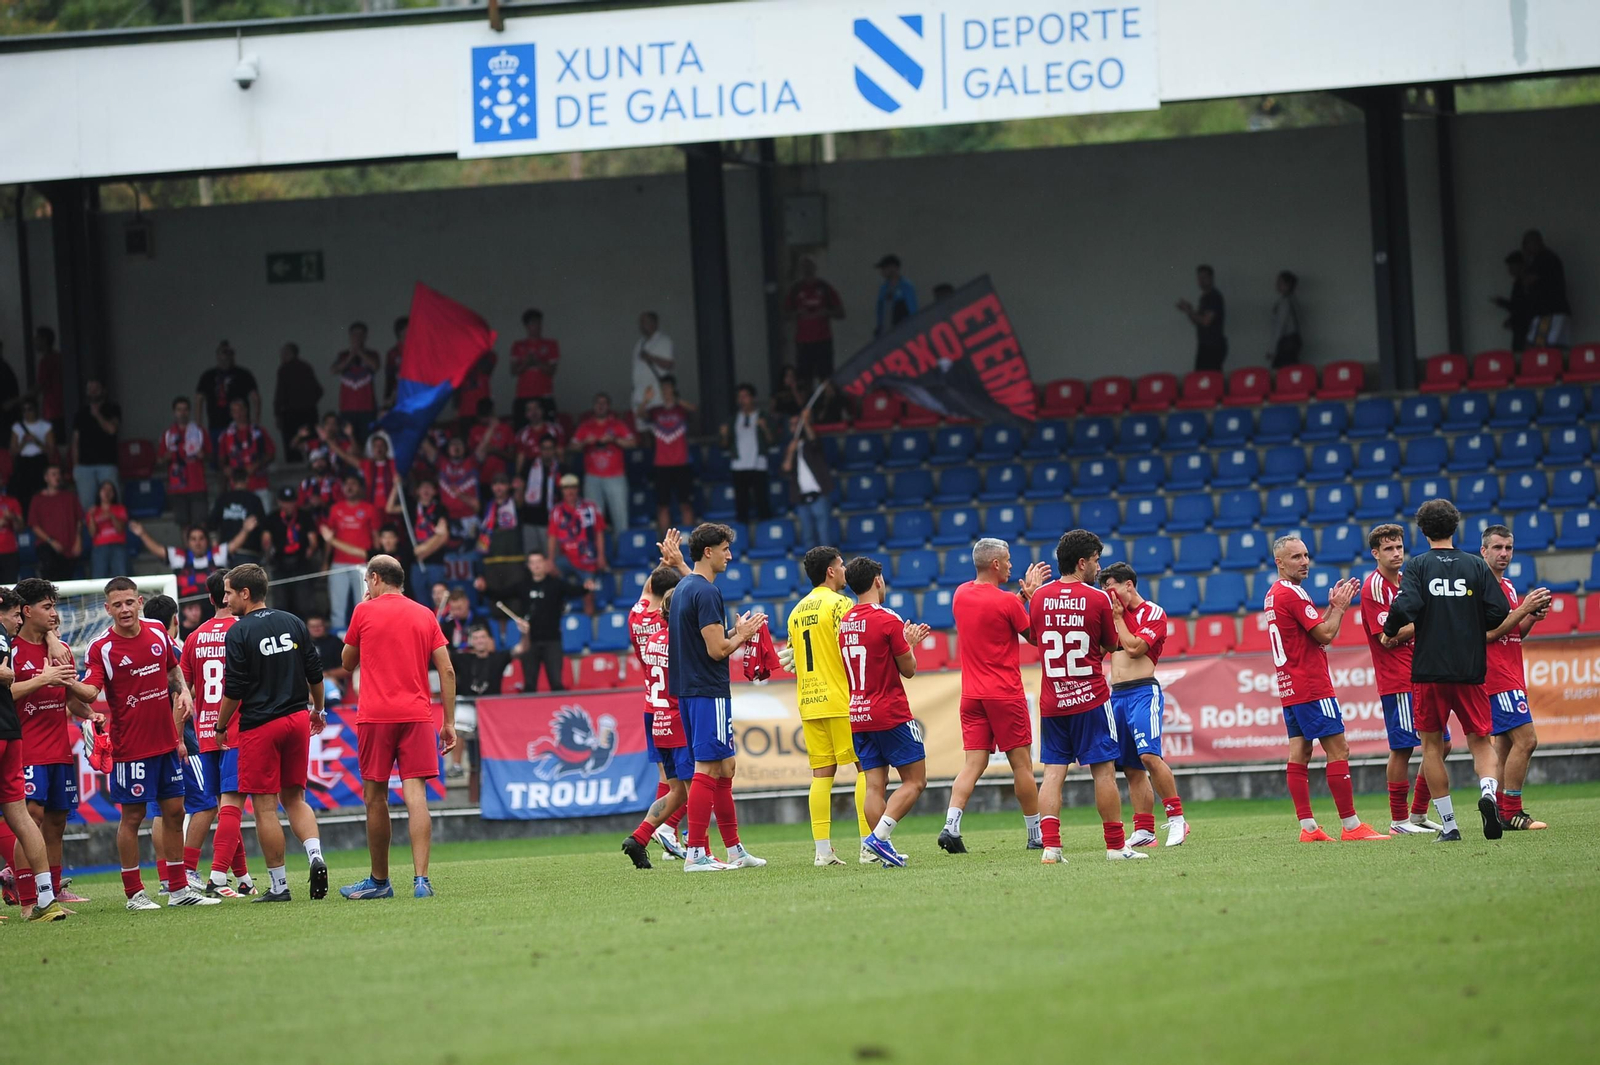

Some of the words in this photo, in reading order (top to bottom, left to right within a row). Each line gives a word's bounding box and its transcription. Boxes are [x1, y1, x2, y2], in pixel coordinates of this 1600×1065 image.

[963, 7, 1142, 51] DEPORTE
[555, 41, 704, 84] XUNTA
[962, 57, 1125, 99] GALEGO
[555, 92, 608, 129] DE
[625, 79, 802, 123] GALICIA
[1043, 597, 1086, 611] POVARELO
[1045, 615, 1053, 627] D.
[1055, 612, 1085, 627] TEJÓN
[803, 629, 814, 673] 1
[844, 634, 859, 646] XABI
[1041, 630, 1094, 678] 22
[203, 659, 224, 704] 8
[842, 645, 867, 691] 17
[131, 762, 145, 780] 16
[505, 774, 639, 810] TROULA
